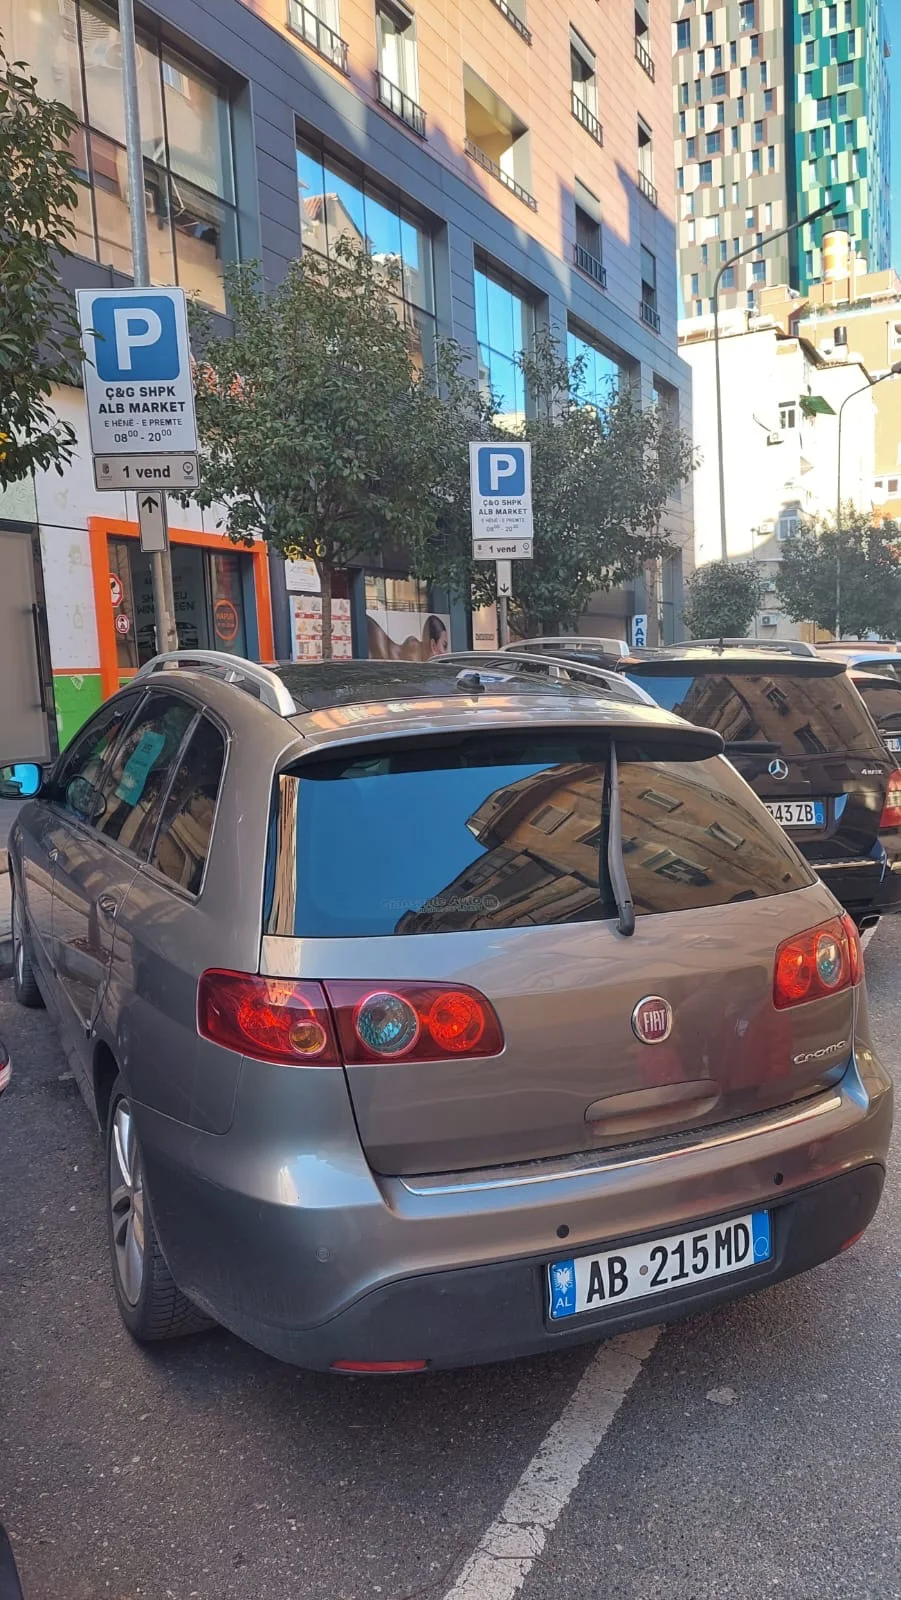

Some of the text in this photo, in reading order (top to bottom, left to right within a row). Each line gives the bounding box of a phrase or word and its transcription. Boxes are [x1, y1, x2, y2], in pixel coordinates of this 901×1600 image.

[114, 308, 162, 371] P
[105, 386, 176, 401] Ç&G SHPK
[98, 402, 186, 414] ALB MARKET
[142, 419, 148, 427] E
[149, 418, 183, 426] PREMTE
[122, 465, 130, 478] 1
[135, 465, 171, 478] vend
[489, 453, 517, 491] P
[489, 545, 494, 553] 1
[496, 545, 517, 553] vend
[643, 1009, 667, 1033] FIAT
[586, 1255, 629, 1304] AB
[555, 1296, 573, 1309] AL
